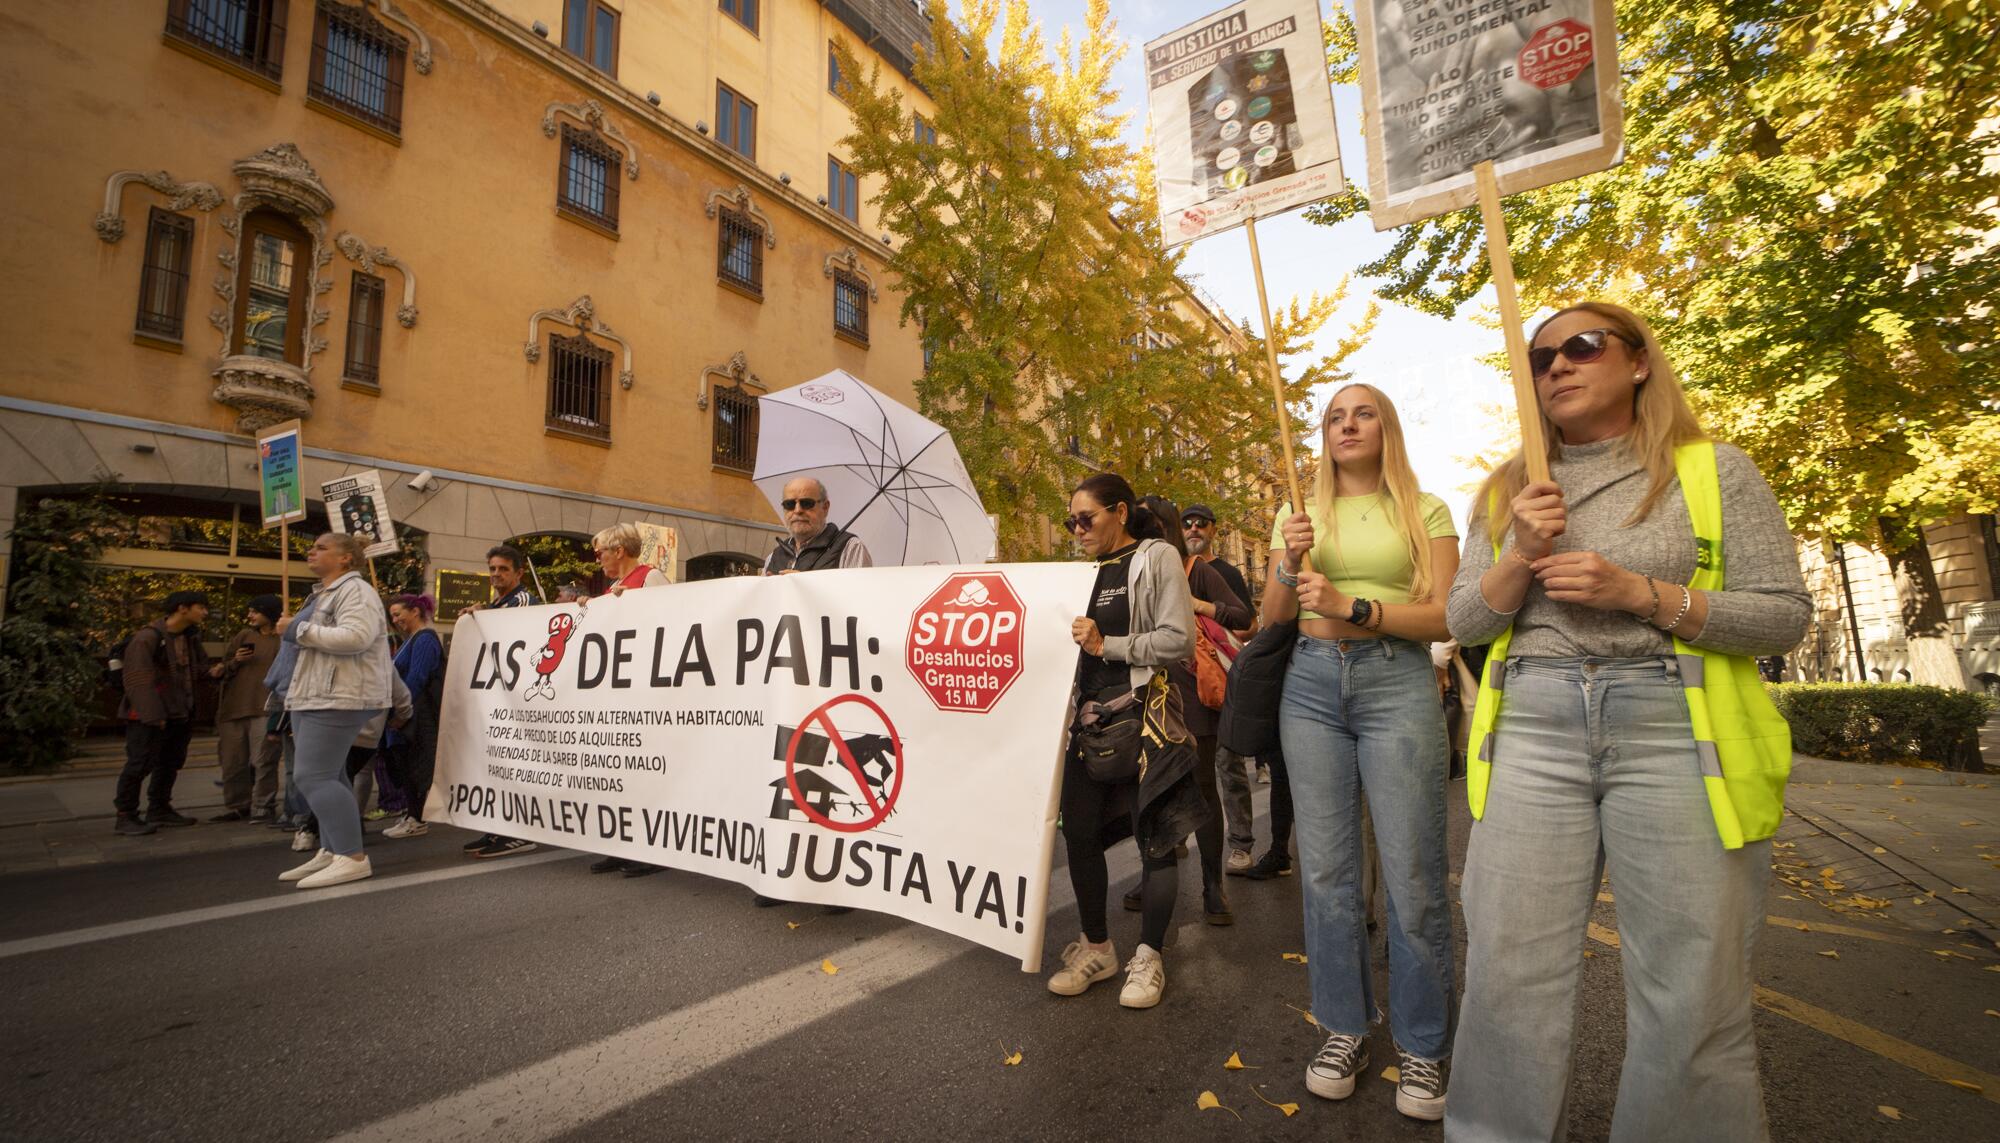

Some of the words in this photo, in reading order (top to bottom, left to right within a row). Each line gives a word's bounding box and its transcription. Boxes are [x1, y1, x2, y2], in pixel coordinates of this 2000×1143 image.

[1416, 8, 1439, 24] LA
[1155, 49, 1166, 61] LA
[1168, 16, 1243, 61] JUSTICIA
[1408, 0, 1552, 59] FUNDAMENTAL
[1412, 21, 1448, 42] SEA
[1170, 49, 1217, 79] SERVICIO
[1220, 46, 1233, 59] DE
[1236, 40, 1249, 53] LA
[1251, 19, 1293, 47] BANCA
[1522, 32, 1590, 68] STOP
[1439, 67, 1461, 84] LO
[1437, 103, 1458, 119] ES
[914, 611, 1017, 647] STOP
[470, 639, 525, 691] LAS
[576, 629, 637, 690] DE
[650, 623, 716, 688] LA
[736, 614, 883, 693] PAH:
[913, 647, 1014, 669] Desahucios
[925, 669, 999, 691] Granada
[945, 689, 961, 705] 15
[964, 690, 978, 706] M
[509, 710, 515, 721] A
[525, 710, 575, 724] DESAHUCIOS
[577, 710, 595, 724] SIN
[597, 710, 673, 725] ALTERNATIVA
[676, 710, 764, 726] HABITACIONAL
[512, 728, 522, 741] AL
[524, 728, 546, 743] PRECIO
[547, 730, 557, 744] DE
[559, 731, 576, 745] LOS
[578, 731, 642, 748] ALQUILERES
[531, 749, 541, 763] DE
[543, 750, 551, 764] LA
[552, 751, 577, 767] SAREB
[580, 752, 621, 770] (BANCO
[625, 755, 666, 775] MALO)
[488, 764, 513, 781] PARQUE
[515, 768, 550, 786] PUBLICO
[552, 772, 563, 787] DE
[567, 775, 623, 793] VIVIENDAS
[501, 790, 545, 829] UNA
[549, 798, 589, 837] LEY
[598, 804, 634, 843] DE
[641, 808, 767, 875] VIVIENDA
[777, 832, 933, 905] JUSTA
[947, 859, 1028, 935] YA!
